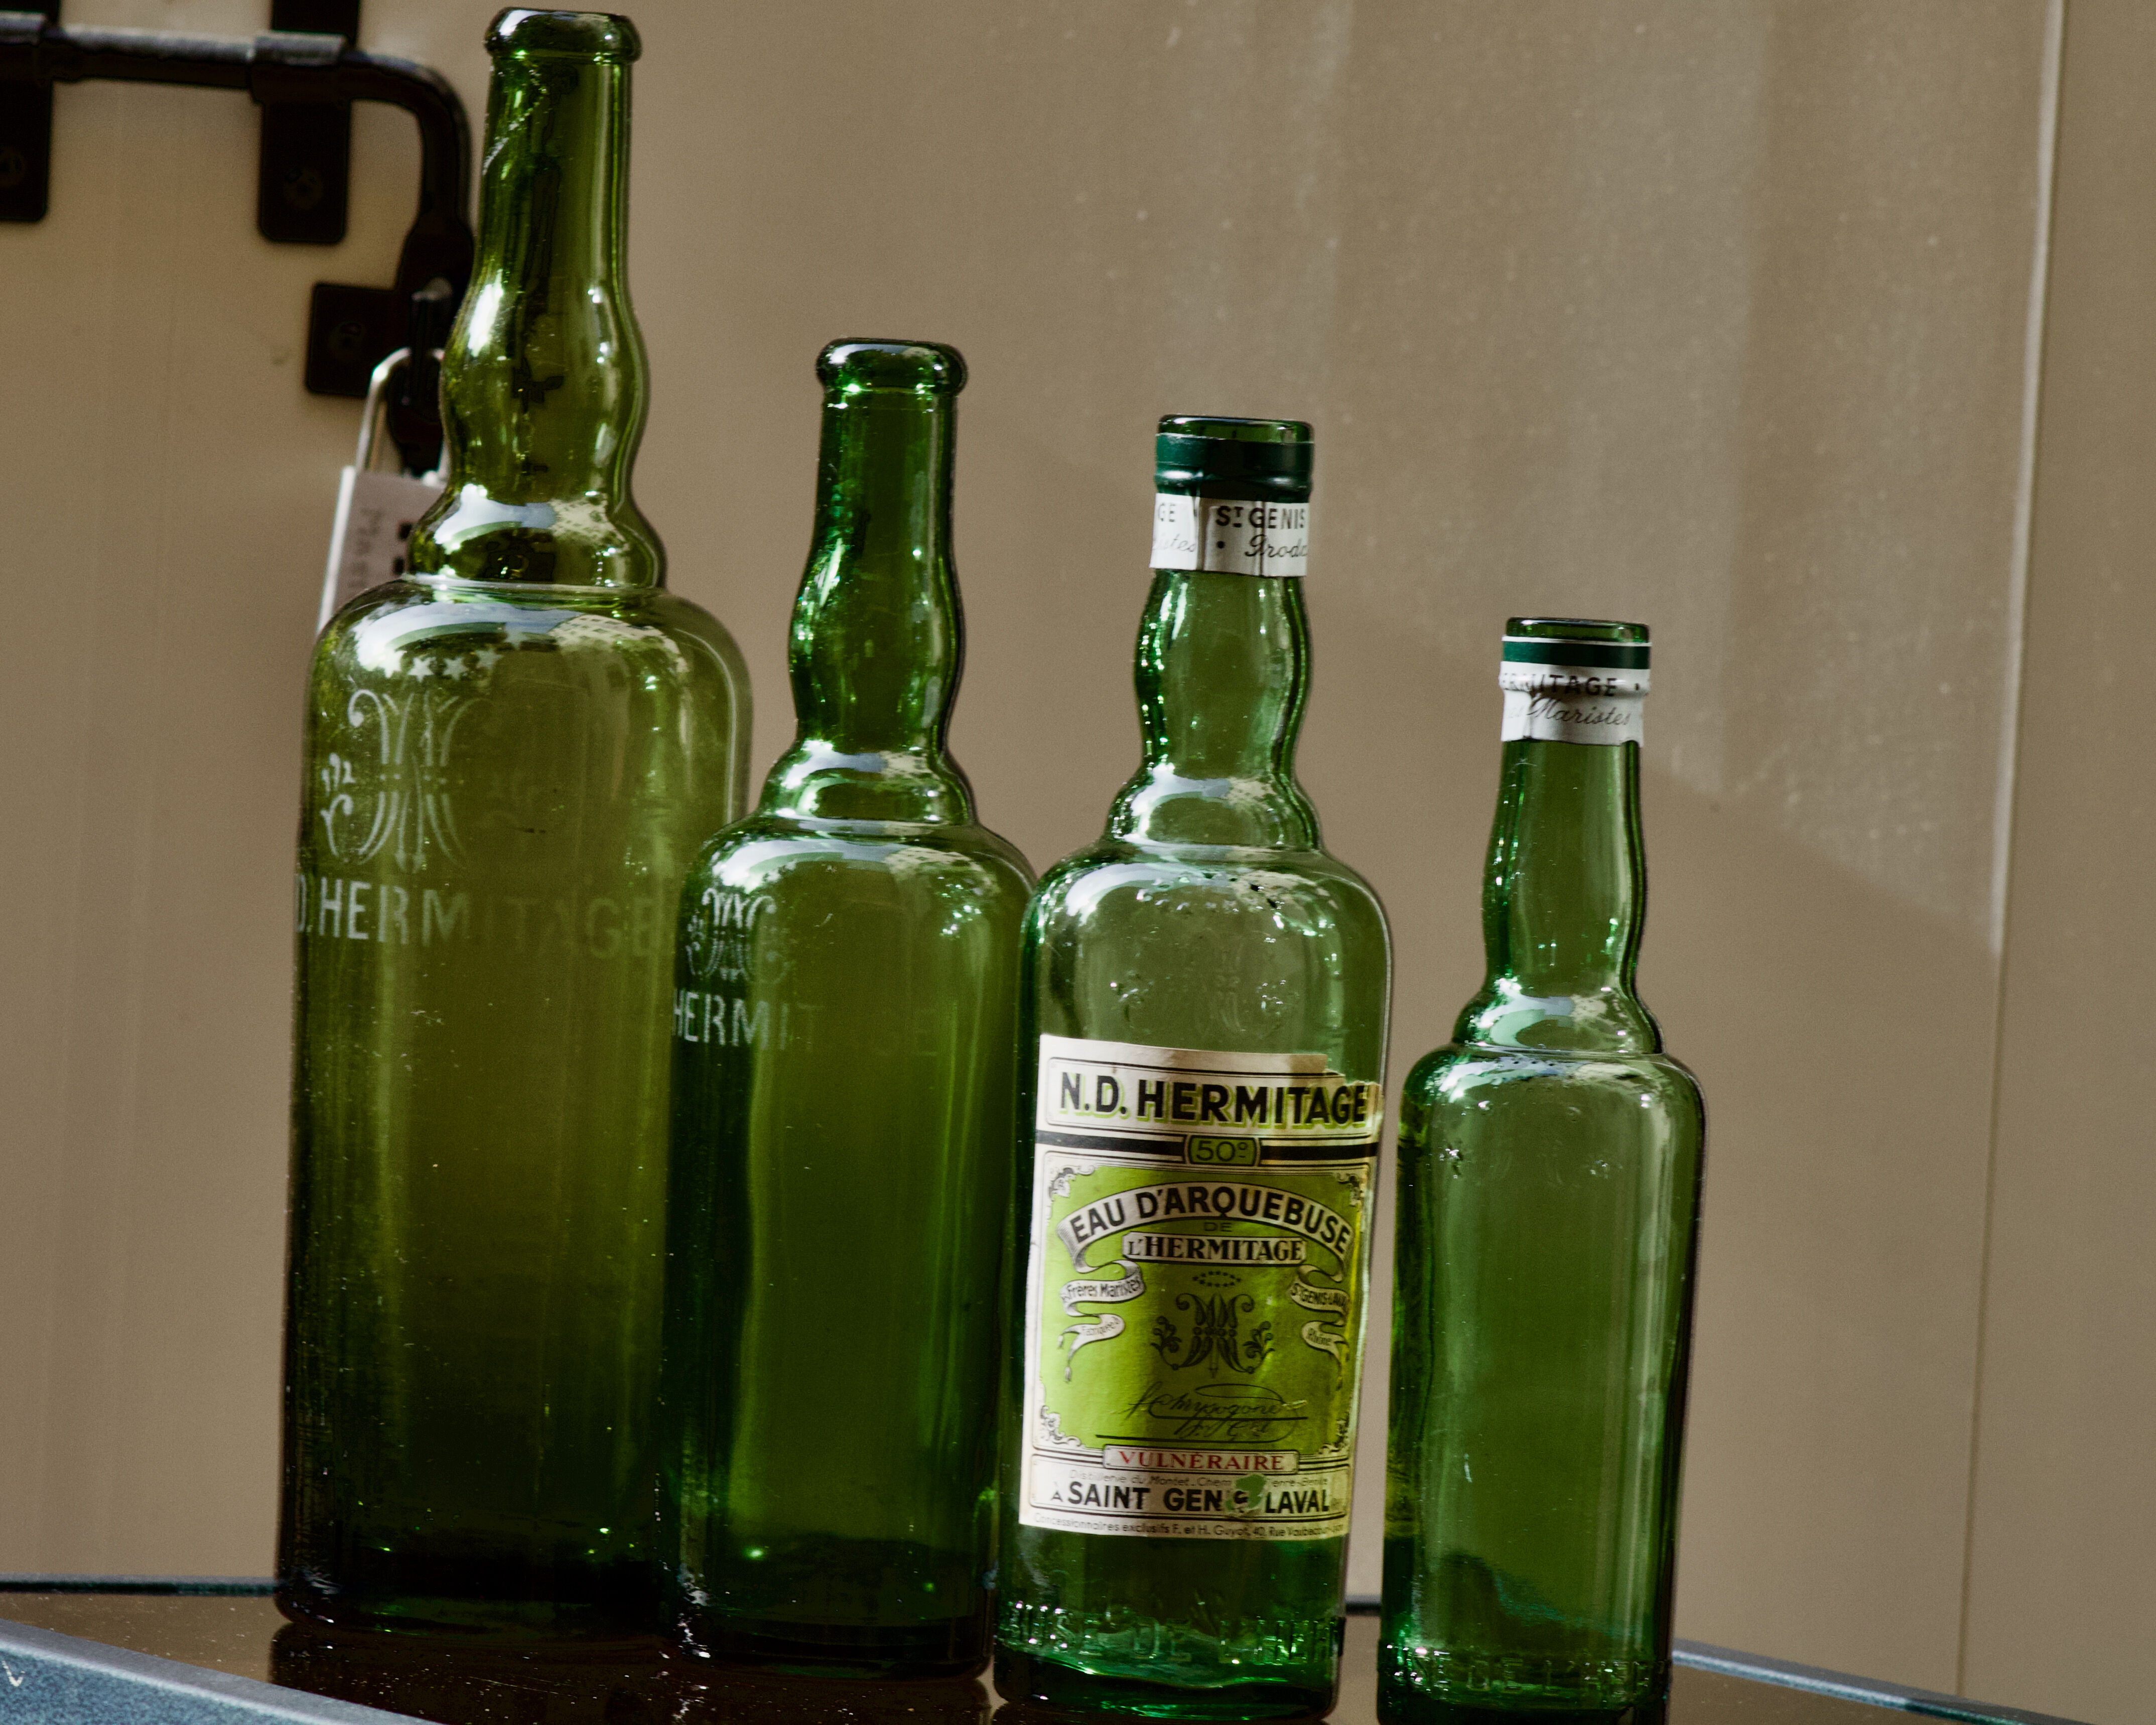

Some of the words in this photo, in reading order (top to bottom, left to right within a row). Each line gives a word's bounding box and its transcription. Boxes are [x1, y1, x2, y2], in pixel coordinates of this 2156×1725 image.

[1061, 1072, 1127, 1115] N.D.
[1138, 1080, 1368, 1125] HERMITAGE
[1069, 1199, 1126, 1244] EAU
[1135, 1185, 1352, 1254] D'ARQUEBUSE
[1204, 1222, 1233, 1233] DE
[1128, 1236, 1304, 1262] L'HERMITAGE
[1119, 1451, 1284, 1471] VULNÉRAIRE
[1068, 1481, 1151, 1510] SAINT
[1265, 1489, 1329, 1514] LAVAL
